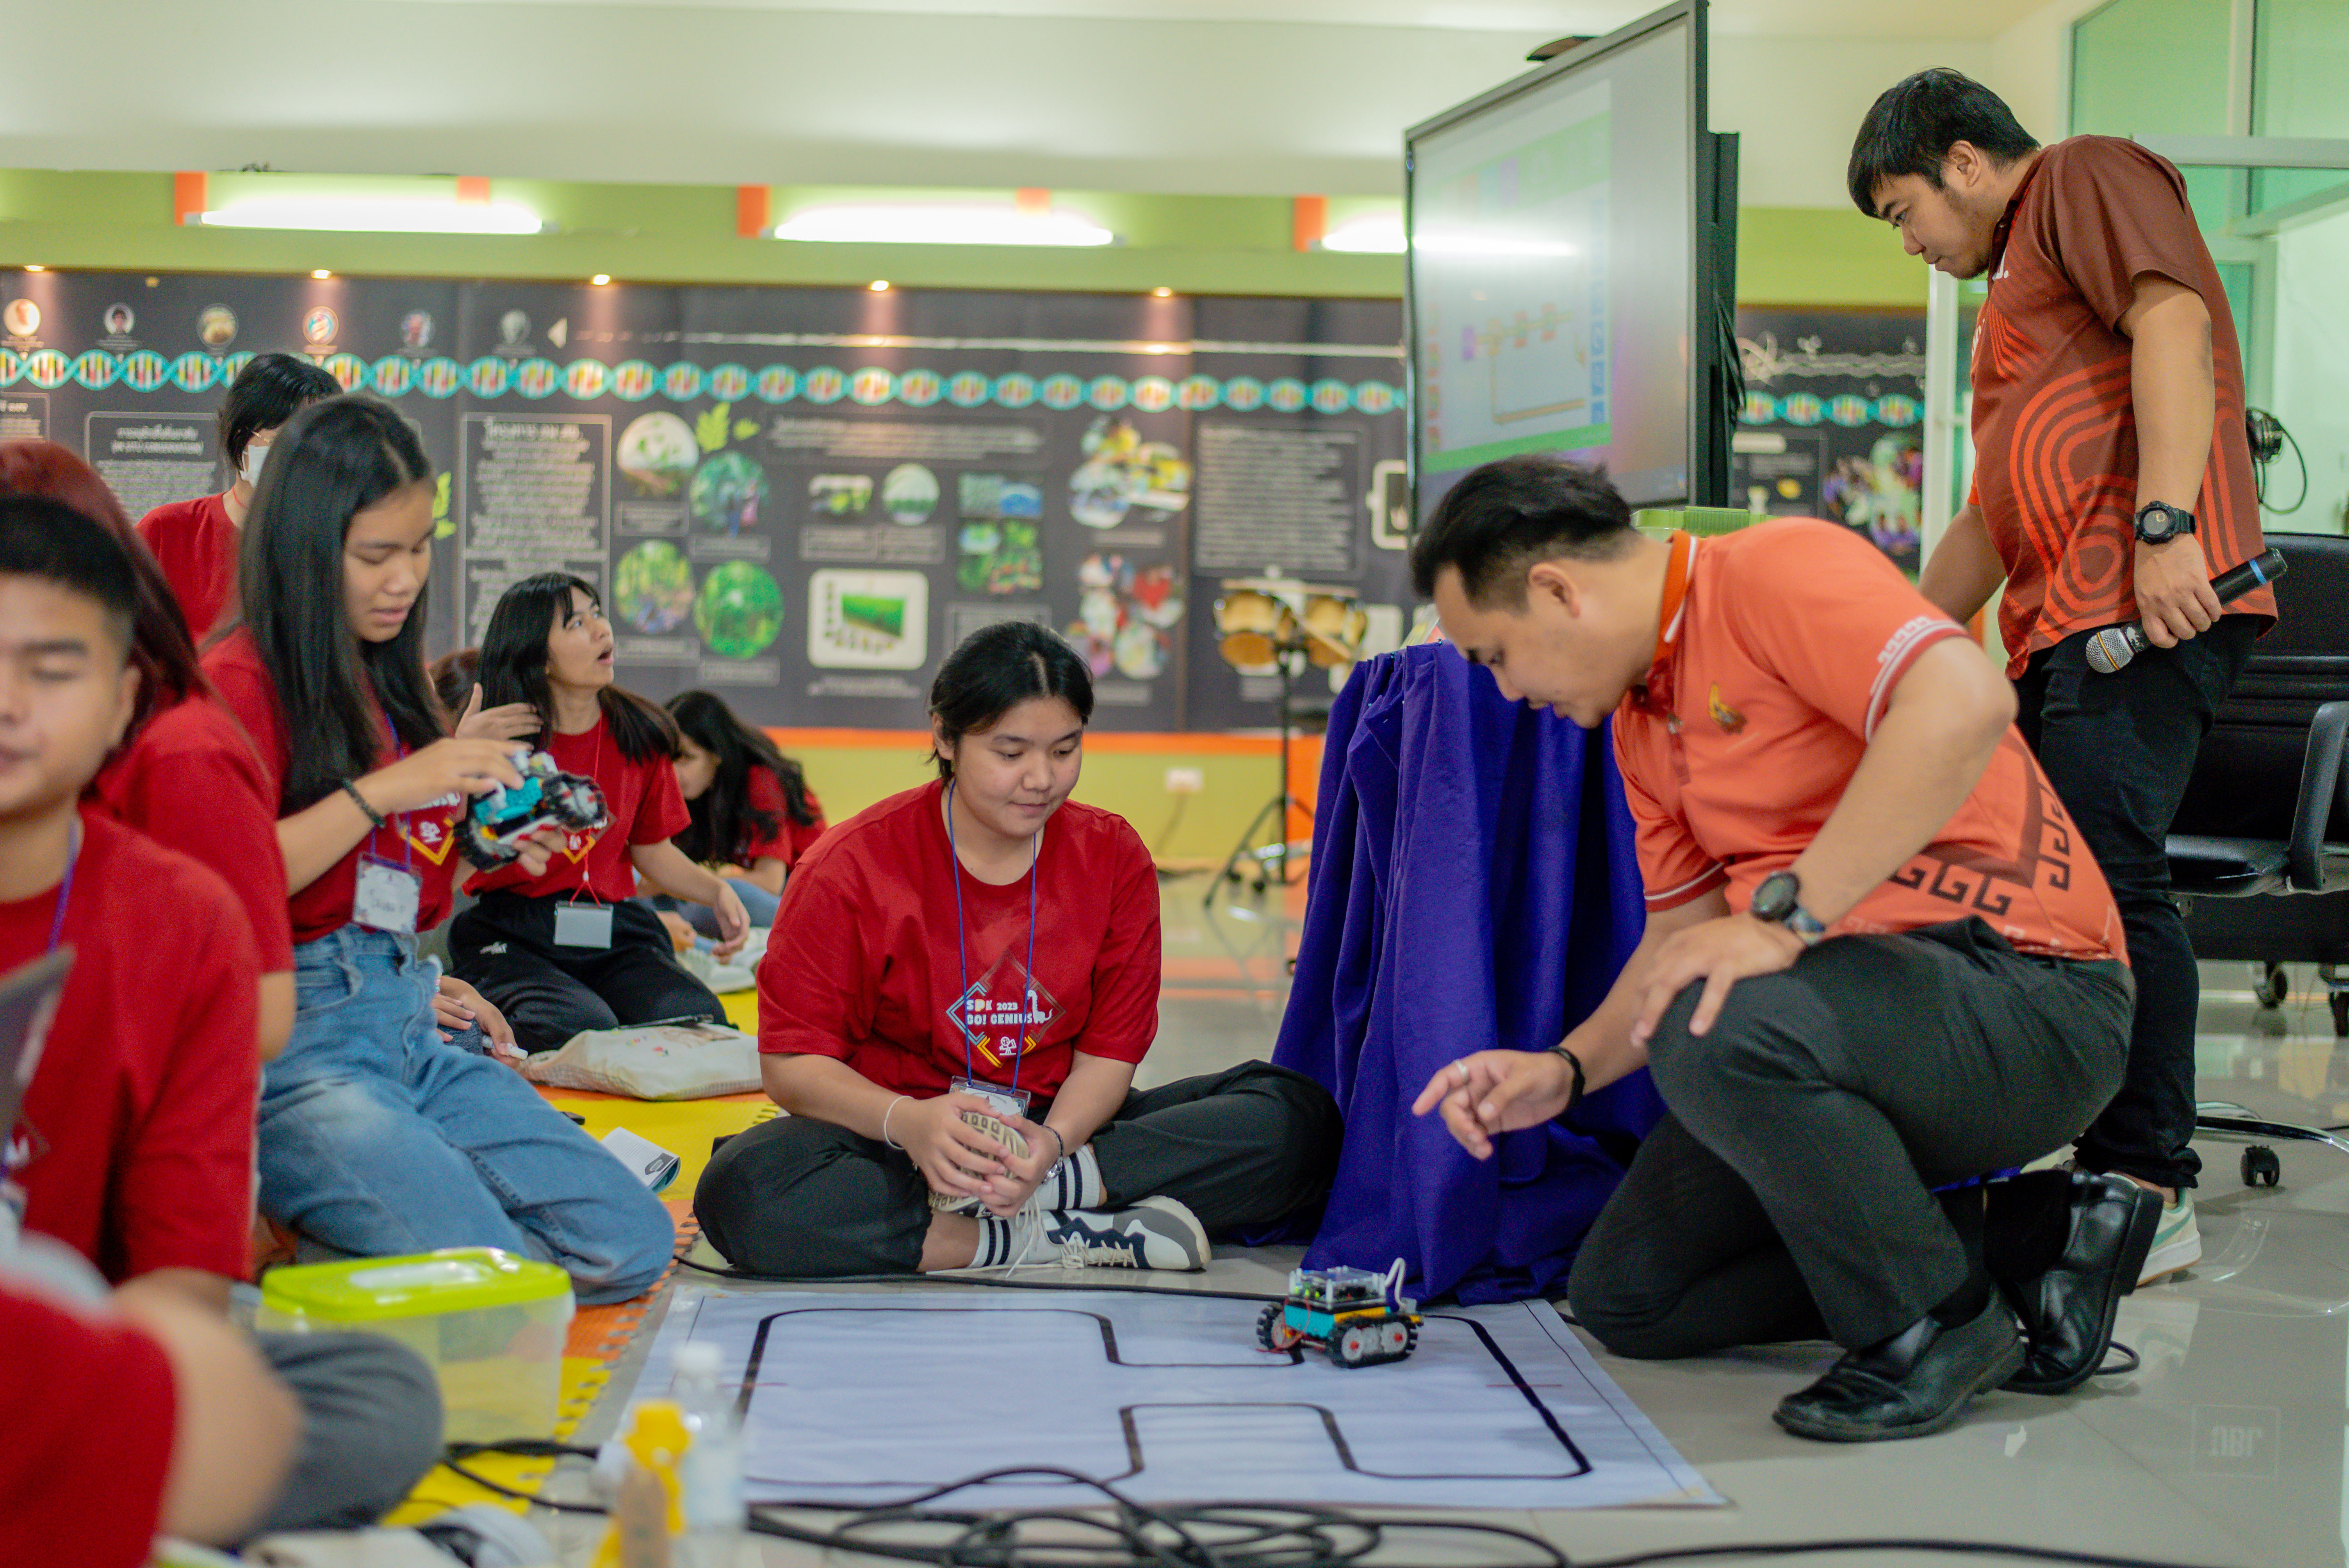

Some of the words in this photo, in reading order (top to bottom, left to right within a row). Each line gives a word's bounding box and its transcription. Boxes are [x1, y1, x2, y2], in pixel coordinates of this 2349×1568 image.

[966, 999, 992, 1012] SPK
[996, 1002, 1018, 1011] 2023
[967, 1014, 987, 1025] GO!
[991, 1013, 1032, 1025] GENIUS
